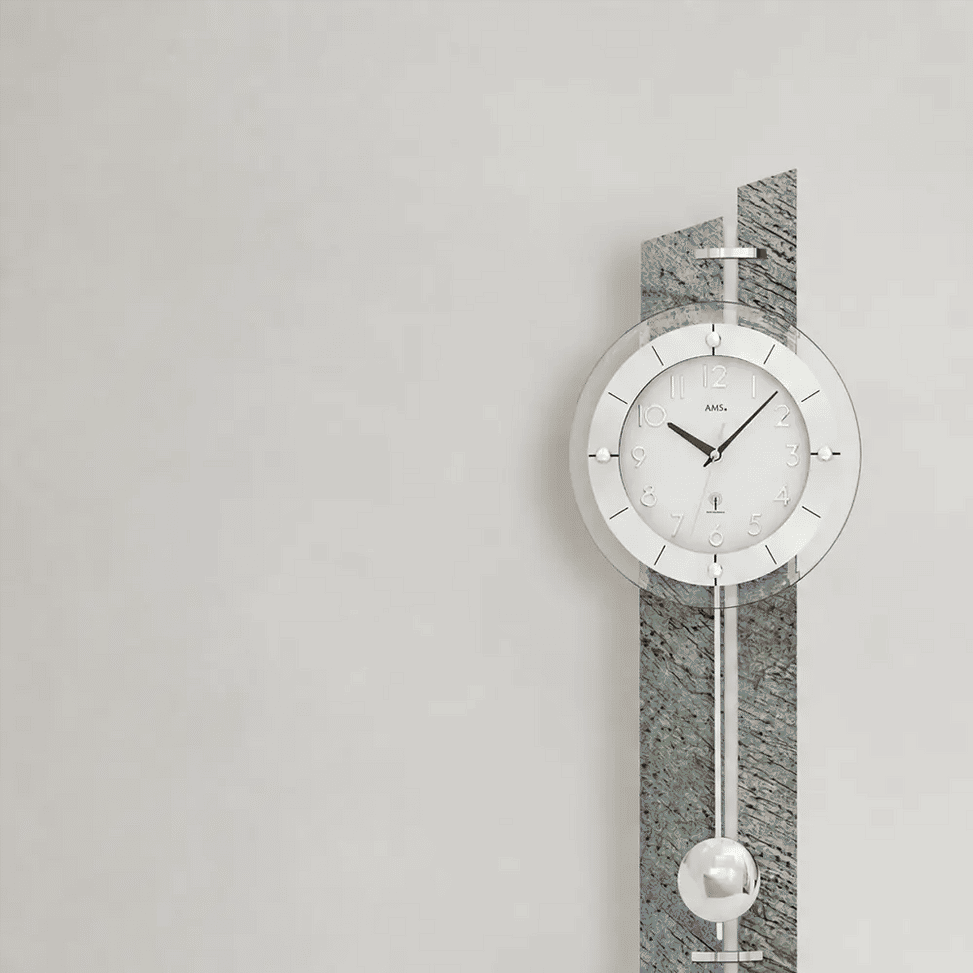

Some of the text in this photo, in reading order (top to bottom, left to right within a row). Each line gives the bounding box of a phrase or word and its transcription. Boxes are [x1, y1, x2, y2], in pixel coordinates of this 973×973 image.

[670, 374, 684, 400] 11
[702, 364, 728, 389] 12
[637, 404, 667, 428] 10
[774, 404, 790, 428] 2
[632, 445, 647, 469] 9
[786, 444, 800, 467] 3
[640, 484, 657, 507] 8
[773, 484, 790, 507] 4
[670, 513, 684, 538] 7
[708, 524, 724, 547] 6
[746, 513, 762, 537] 5
